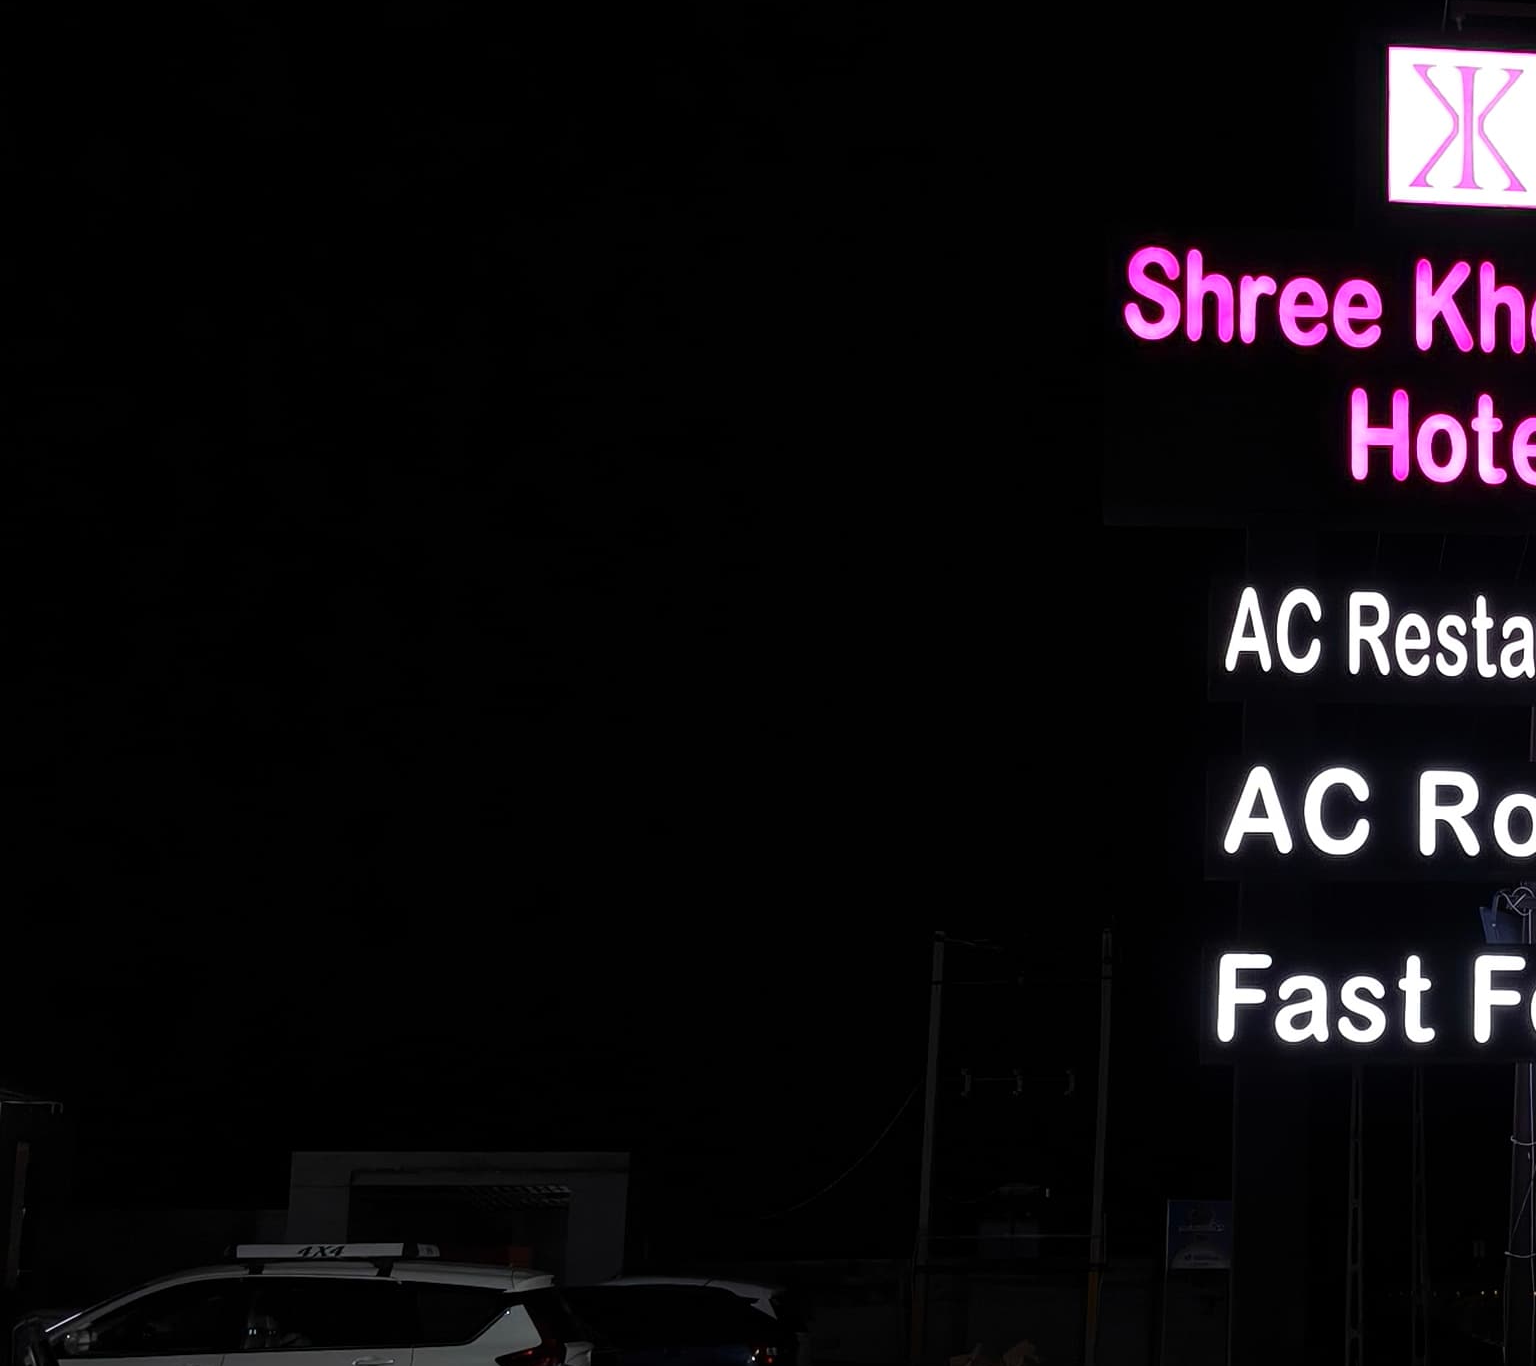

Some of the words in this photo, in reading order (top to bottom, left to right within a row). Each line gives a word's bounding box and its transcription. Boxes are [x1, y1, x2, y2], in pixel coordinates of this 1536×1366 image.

[1123, 245, 1384, 350] Shree
[1224, 585, 1323, 675] AC
[1222, 764, 1371, 856] AC
[1215, 952, 1437, 1044] Fast
